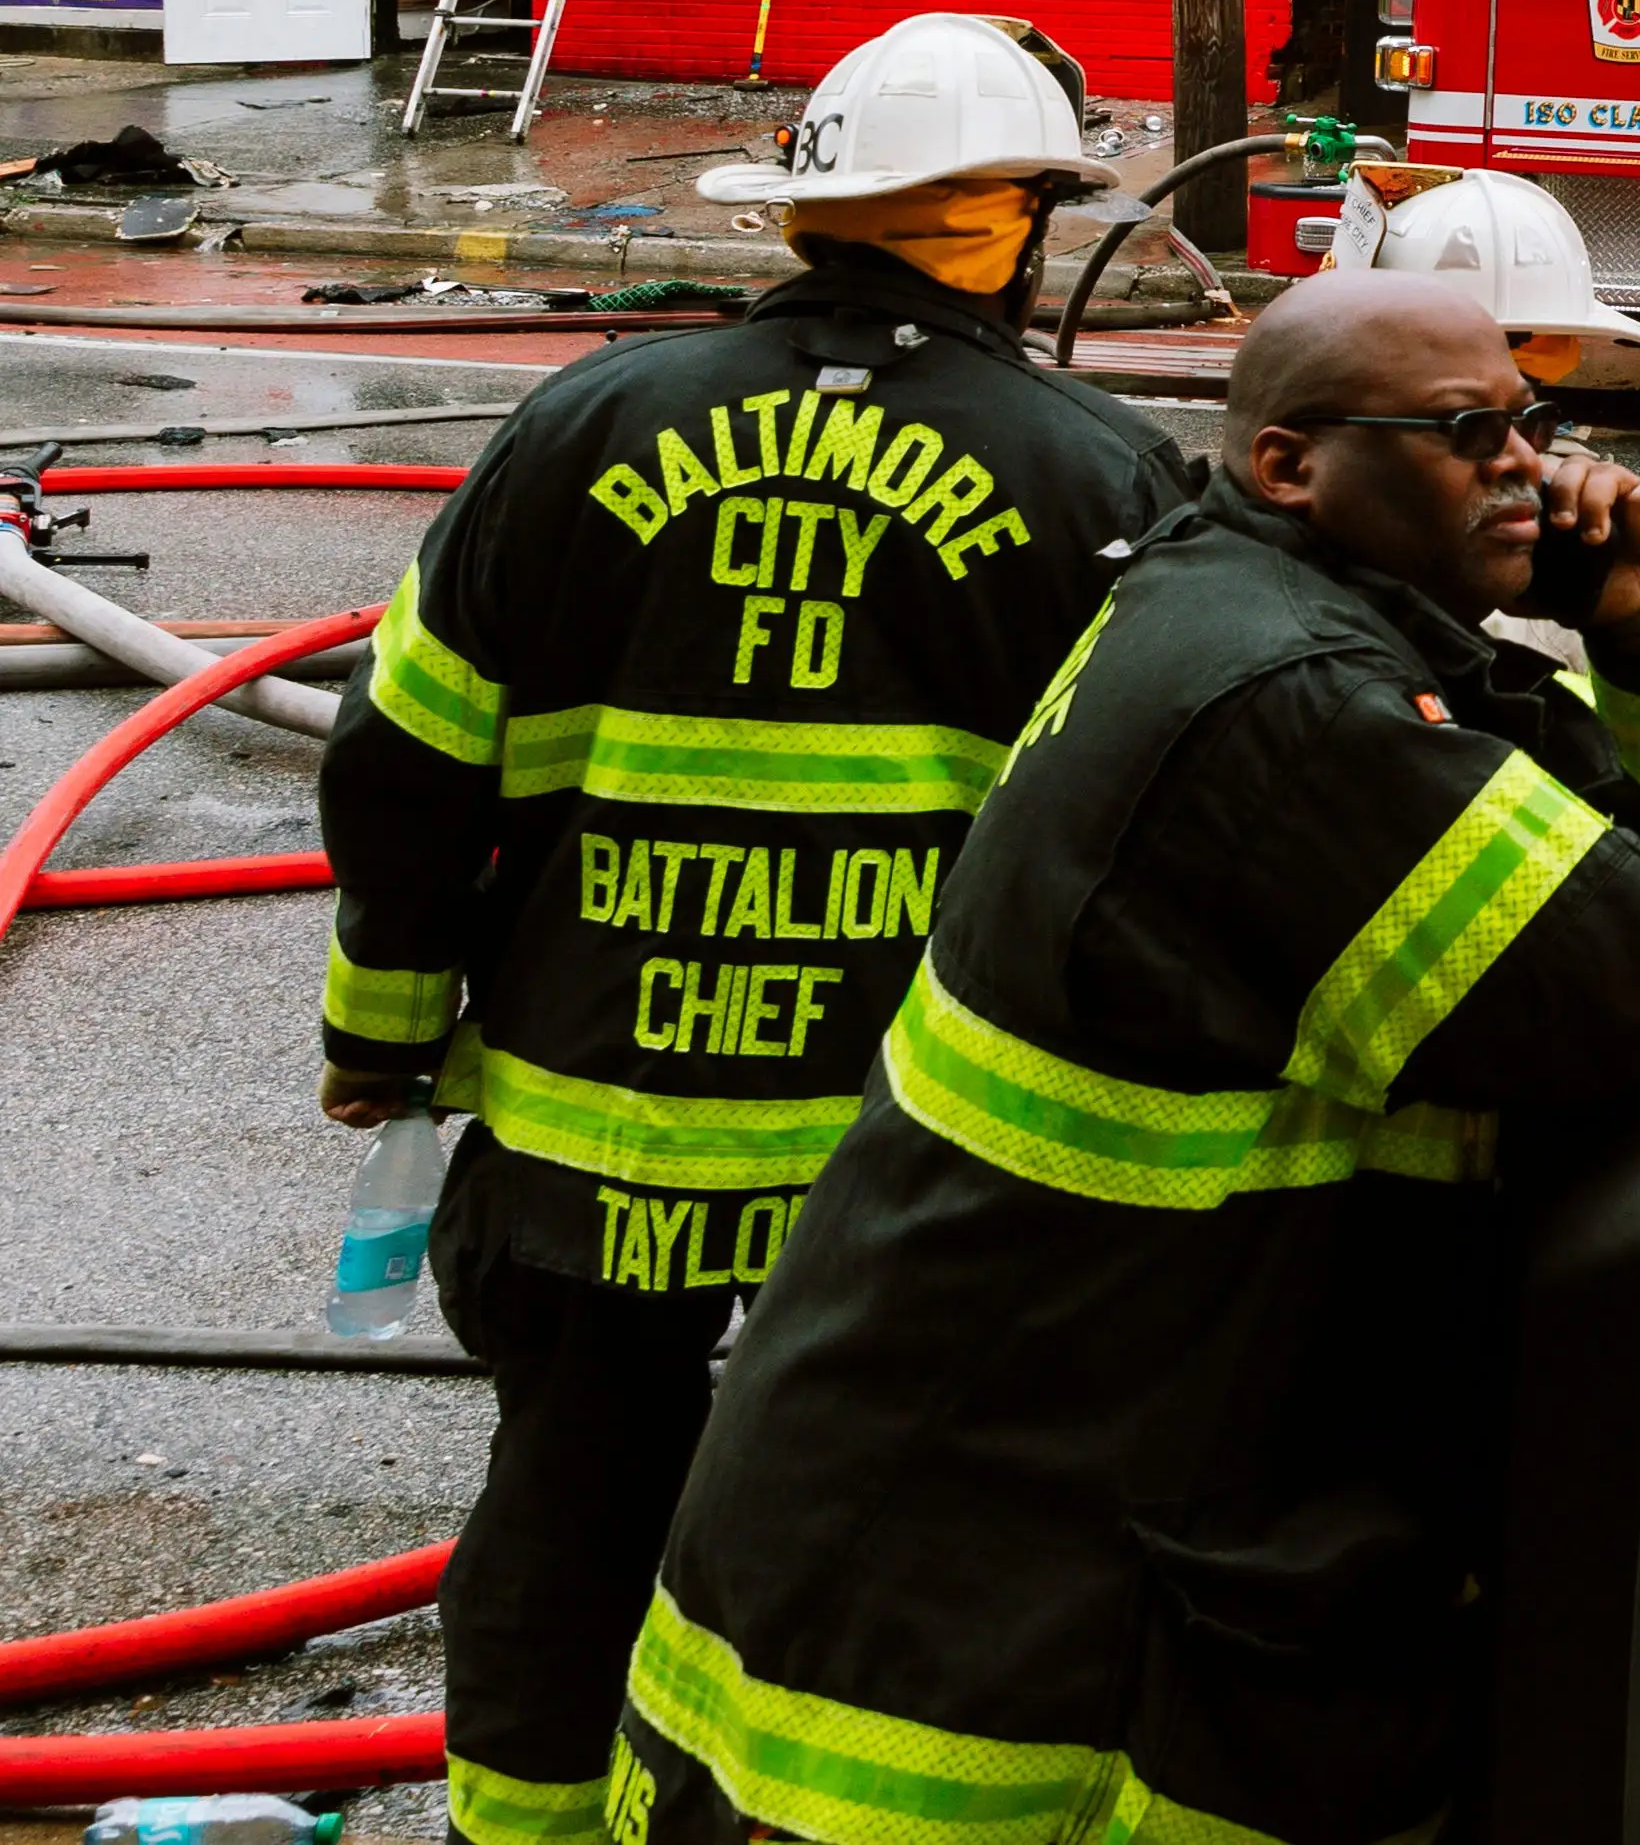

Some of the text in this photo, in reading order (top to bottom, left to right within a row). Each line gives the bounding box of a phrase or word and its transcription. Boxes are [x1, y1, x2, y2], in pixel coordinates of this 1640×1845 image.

[1601, 47, 1618, 60] FIRE
[1524, 100, 1577, 126] ISO
[1351, 198, 1376, 225] CHIEF
[589, 389, 1031, 581] BALTIMORE
[711, 496, 892, 598] CITY
[733, 595, 845, 689] FD
[580, 832, 940, 940] BATTALION
[633, 956, 844, 1057] CHIEF
